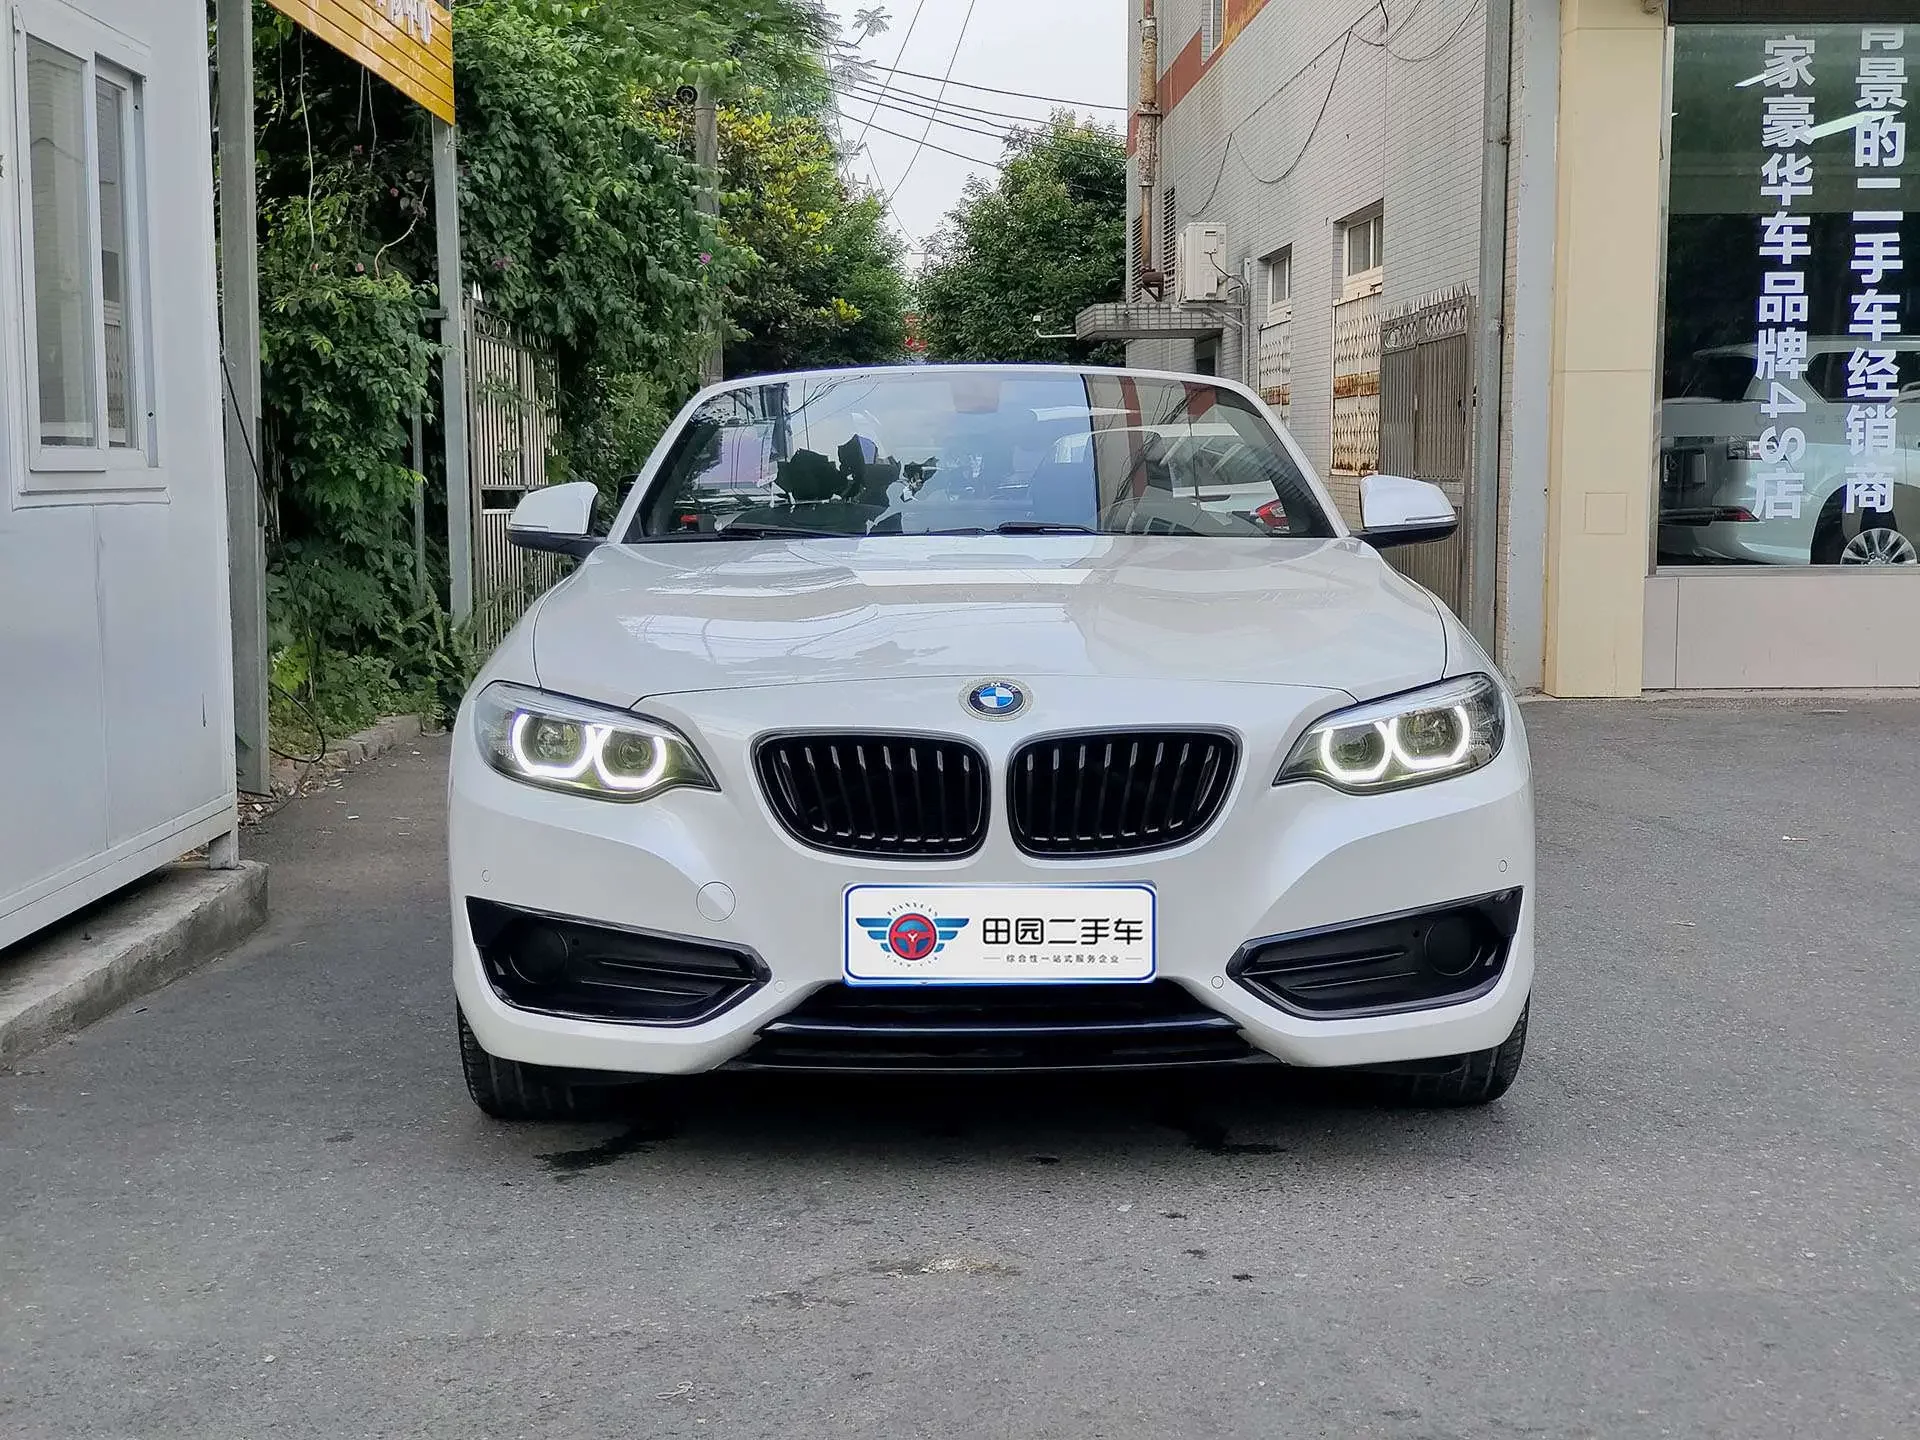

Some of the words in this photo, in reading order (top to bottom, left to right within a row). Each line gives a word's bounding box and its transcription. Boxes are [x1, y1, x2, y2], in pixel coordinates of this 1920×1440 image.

[1752, 35, 1817, 520] 家豪华车品牌4S店
[983, 917, 1143, 945] 田园二手车
[1006, 953, 1120, 964] 综合性一站式服务企业
